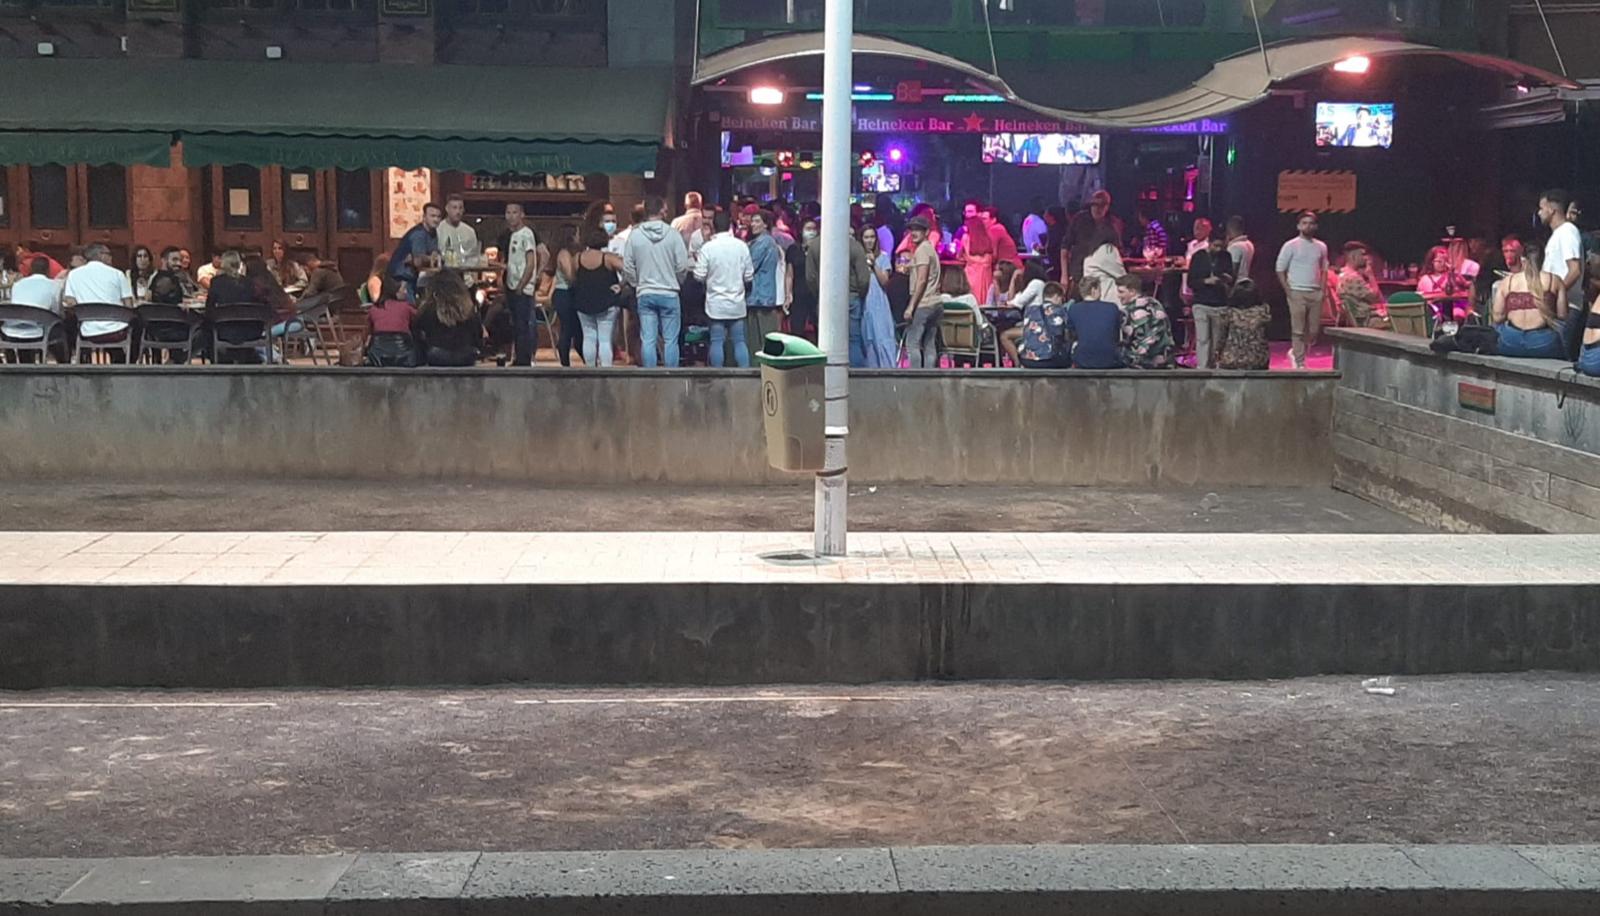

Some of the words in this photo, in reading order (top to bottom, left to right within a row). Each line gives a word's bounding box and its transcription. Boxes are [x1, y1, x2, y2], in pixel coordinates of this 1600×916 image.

[721, 116, 788, 129] Heineken
[791, 116, 817, 130] Bar
[857, 118, 925, 131] Heineken
[928, 117, 954, 131] Bar
[995, 119, 1060, 131] Heineken
[1200, 118, 1227, 133] Bar
